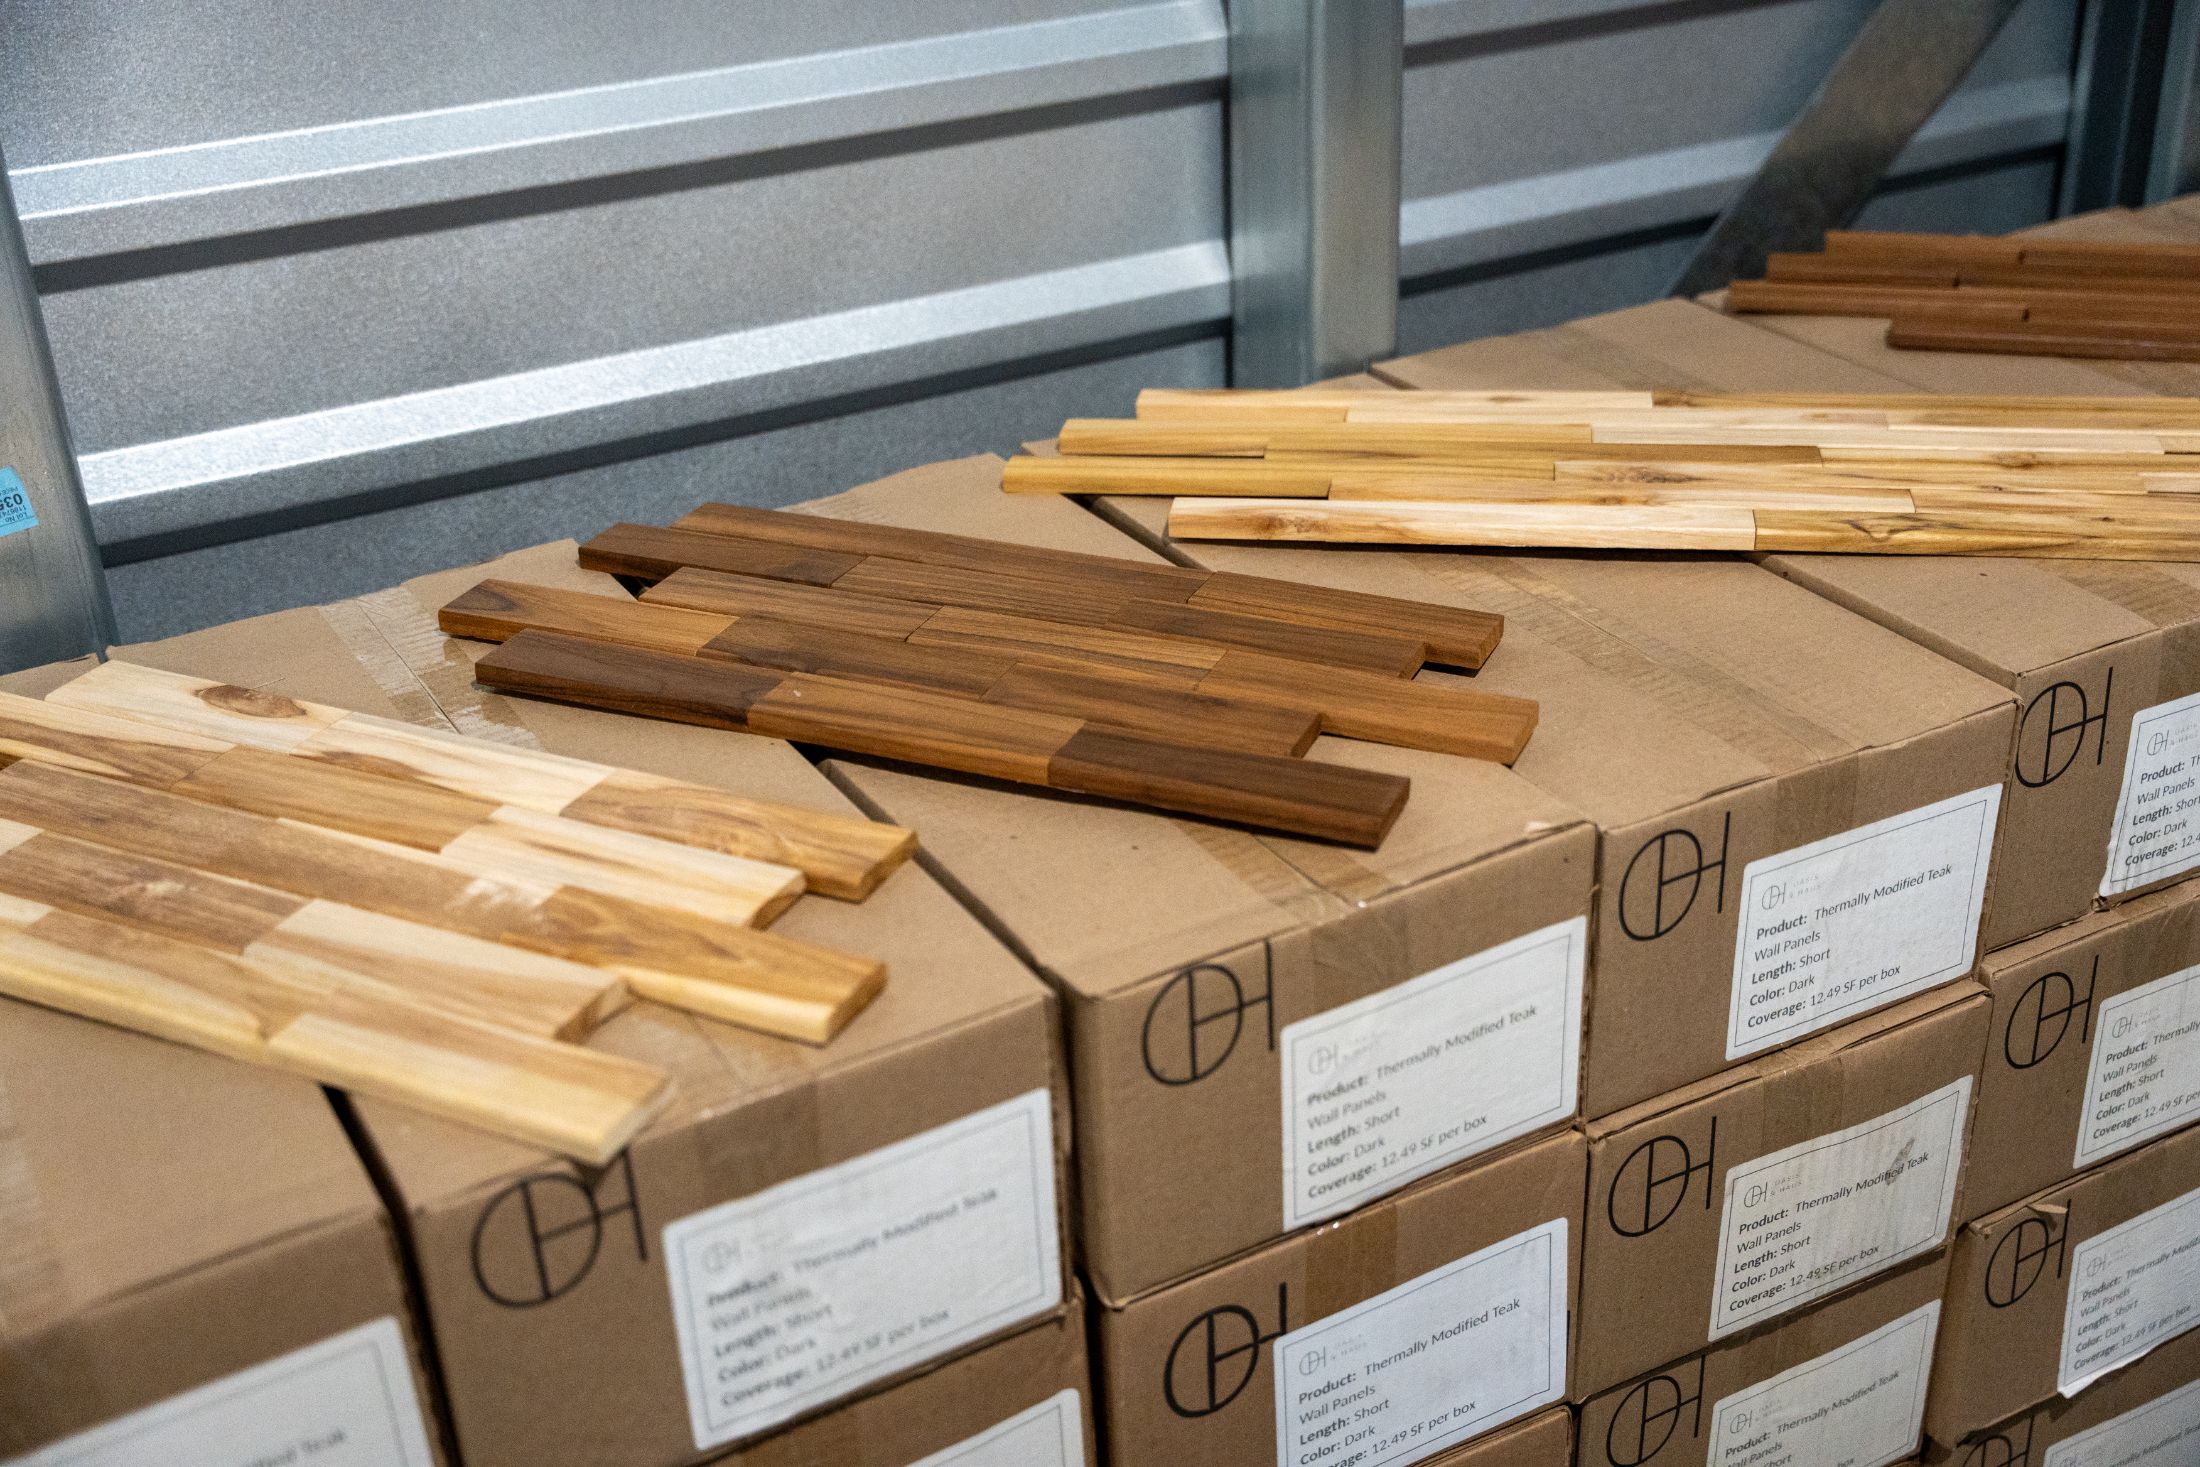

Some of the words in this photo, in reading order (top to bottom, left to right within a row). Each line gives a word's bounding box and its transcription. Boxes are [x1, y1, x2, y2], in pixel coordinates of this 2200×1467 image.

[2136, 788, 2159, 805] Wall
[2161, 777, 2195, 796] Panels
[2139, 762, 2185, 784] Product:
[2128, 829, 2160, 846] Color:
[2162, 818, 2187, 835] Dark
[2131, 805, 2172, 826] Length:
[2124, 843, 2177, 866] Coverage:
[1756, 914, 1807, 940] Product:
[1815, 892, 1870, 920] Thermally
[1873, 871, 1924, 899] Modified
[1927, 863, 1951, 880] Teak
[1754, 942, 1780, 961] Wall
[1783, 930, 1820, 952] Panels
[1751, 960, 1796, 984] Length:
[1799, 947, 1830, 967] Short
[1747, 1000, 1805, 1028] Coverage:
[1810, 985, 1840, 1006] 12.49
[1842, 978, 1856, 993] SF
[1858, 973, 1877, 990] per
[1880, 965, 1900, 980] box
[1749, 986, 1785, 1006] Color:
[1788, 973, 1814, 993] Dark
[1307, 1073, 1367, 1105] Product:
[1377, 1043, 1442, 1077] Thermally
[1445, 1015, 1504, 1049] Modified
[1508, 1004, 1536, 1024] Teak
[2103, 1066, 2124, 1083] Wall
[2125, 1054, 2156, 1074] Panels
[2105, 1041, 2148, 1064] Product:
[1343, 1088, 1386, 1115] Panels
[2098, 1081, 2136, 1102] Length:
[2137, 1069, 2163, 1087] Short
[2092, 1114, 2141, 1139] Coverage:
[2144, 1100, 2170, 1119] 12.49
[2170, 1095, 2182, 1109] SF
[2095, 1103, 2125, 1120] Color:
[2127, 1092, 2149, 1109] Dark
[1308, 1123, 1360, 1152] Length:
[1364, 1105, 1400, 1129] Short
[1307, 1151, 1349, 1175] Color:
[1354, 1135, 1385, 1157] Dark
[1307, 1163, 1377, 1198] Coverage:
[1382, 1142, 1417, 1168] 12.49
[1420, 1134, 1435, 1150] SF
[1439, 1126, 1460, 1145] per
[1464, 1115, 1487, 1132] box
[1739, 1208, 1788, 1235] Product:
[1796, 1185, 1852, 1212] Thermally
[1855, 1163, 1904, 1193] Modified
[1906, 1152, 1928, 1170] Teak
[1734, 1249, 1777, 1274] Length:
[1780, 1235, 1810, 1255] Short
[1737, 1234, 1762, 1253] Wall
[1765, 1221, 1801, 1243] Panels
[1729, 1282, 1786, 1311] Coverage:
[1791, 1266, 1820, 1287] 12.49
[1822, 1260, 1835, 1274] SF
[1838, 1253, 1857, 1269] per
[1859, 1244, 1879, 1258] box
[1731, 1272, 1766, 1293] Color:
[1769, 1258, 1795, 1277] Dark
[1298, 1373, 1355, 1404] Product:
[1364, 1340, 1428, 1375] Thermally
[1430, 1311, 1488, 1345] Modified
[1492, 1299, 1520, 1318] Teak
[1299, 1402, 1328, 1424] Wall
[1332, 1384, 1375, 1410] Panels
[1299, 1417, 1349, 1445] Length:
[1353, 1398, 1389, 1421] Short
[1299, 1441, 1340, 1464] Color:
[1343, 1424, 1374, 1446] Dark
[1372, 1430, 1407, 1454] 12.49
[1409, 1421, 1423, 1437] SF
[1428, 1413, 1449, 1431] per
[1453, 1401, 1475, 1418] box
